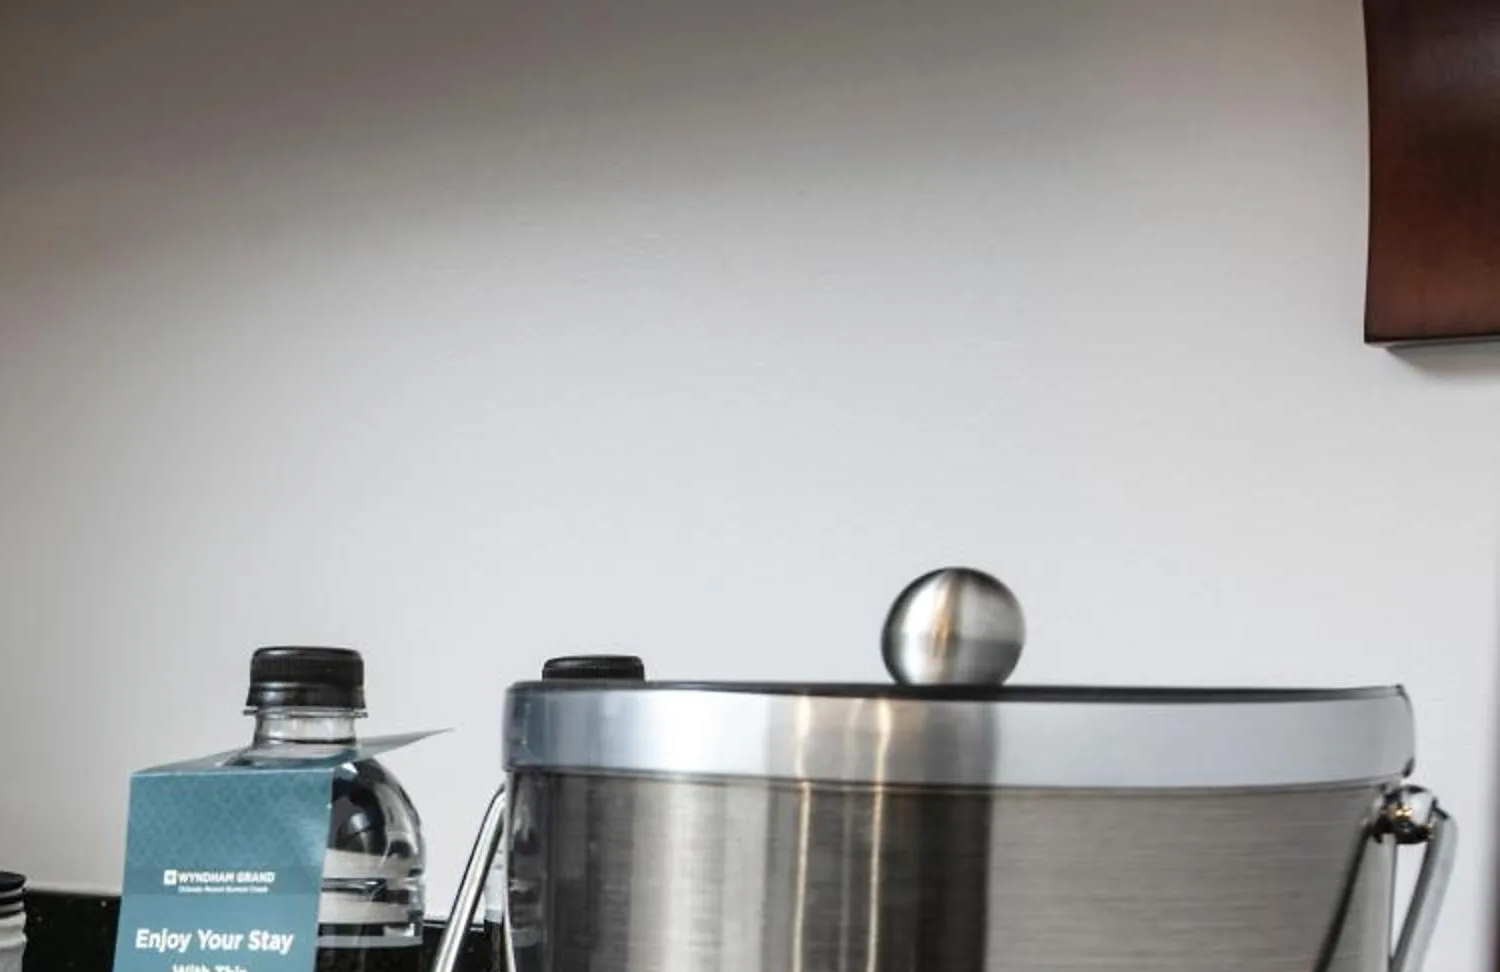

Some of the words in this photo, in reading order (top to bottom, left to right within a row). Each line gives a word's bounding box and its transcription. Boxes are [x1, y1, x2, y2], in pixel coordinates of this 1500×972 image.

[135, 928, 191, 953] Enjoy
[198, 929, 244, 951] Your
[248, 929, 295, 955] Stay
